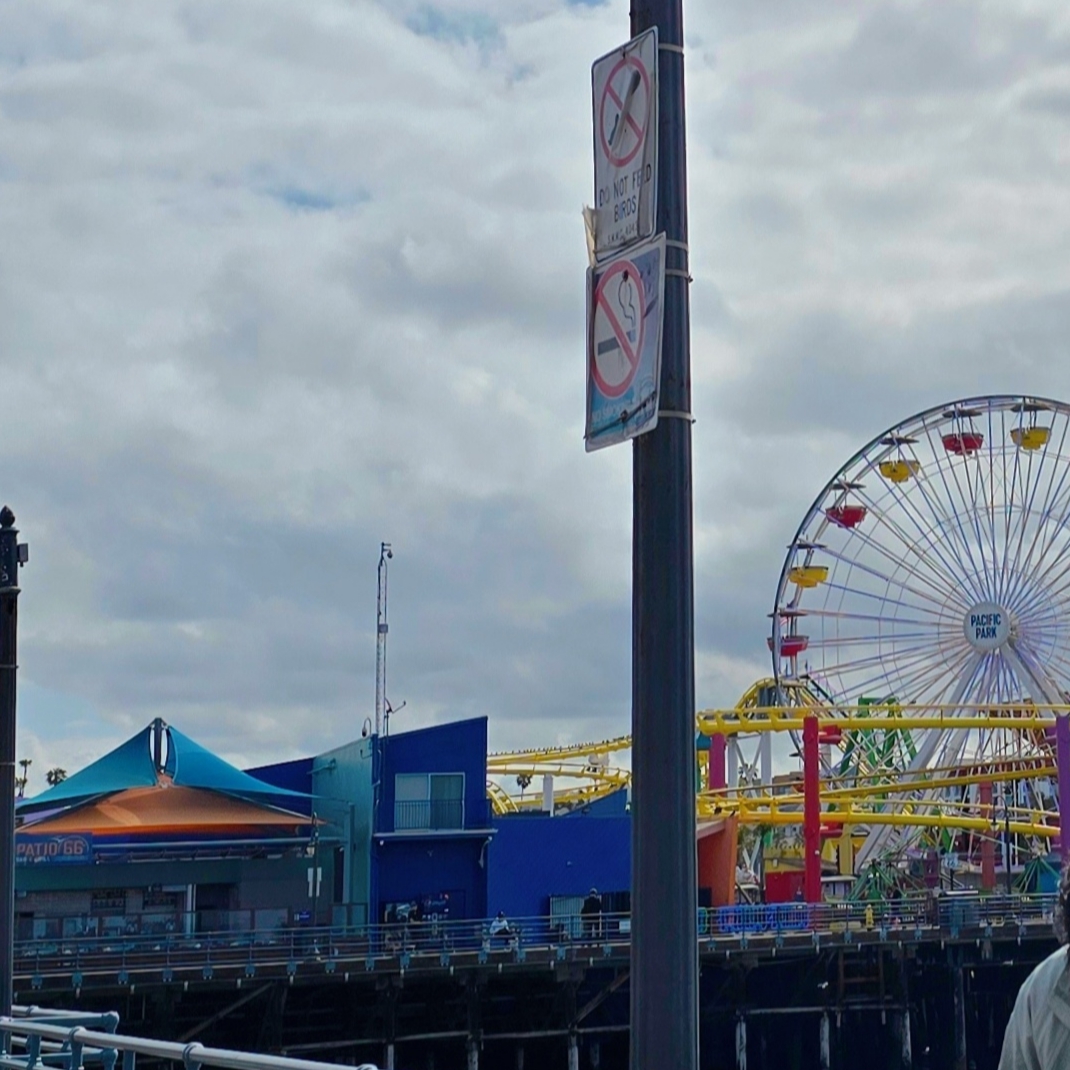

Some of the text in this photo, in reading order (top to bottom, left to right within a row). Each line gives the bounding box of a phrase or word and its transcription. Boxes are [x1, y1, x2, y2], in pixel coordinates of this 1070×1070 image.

[613, 176, 628, 200] NOT
[970, 613, 1002, 627] PACIFIC
[975, 626, 997, 640] PARK
[16, 840, 85, 856] PATIO 66
